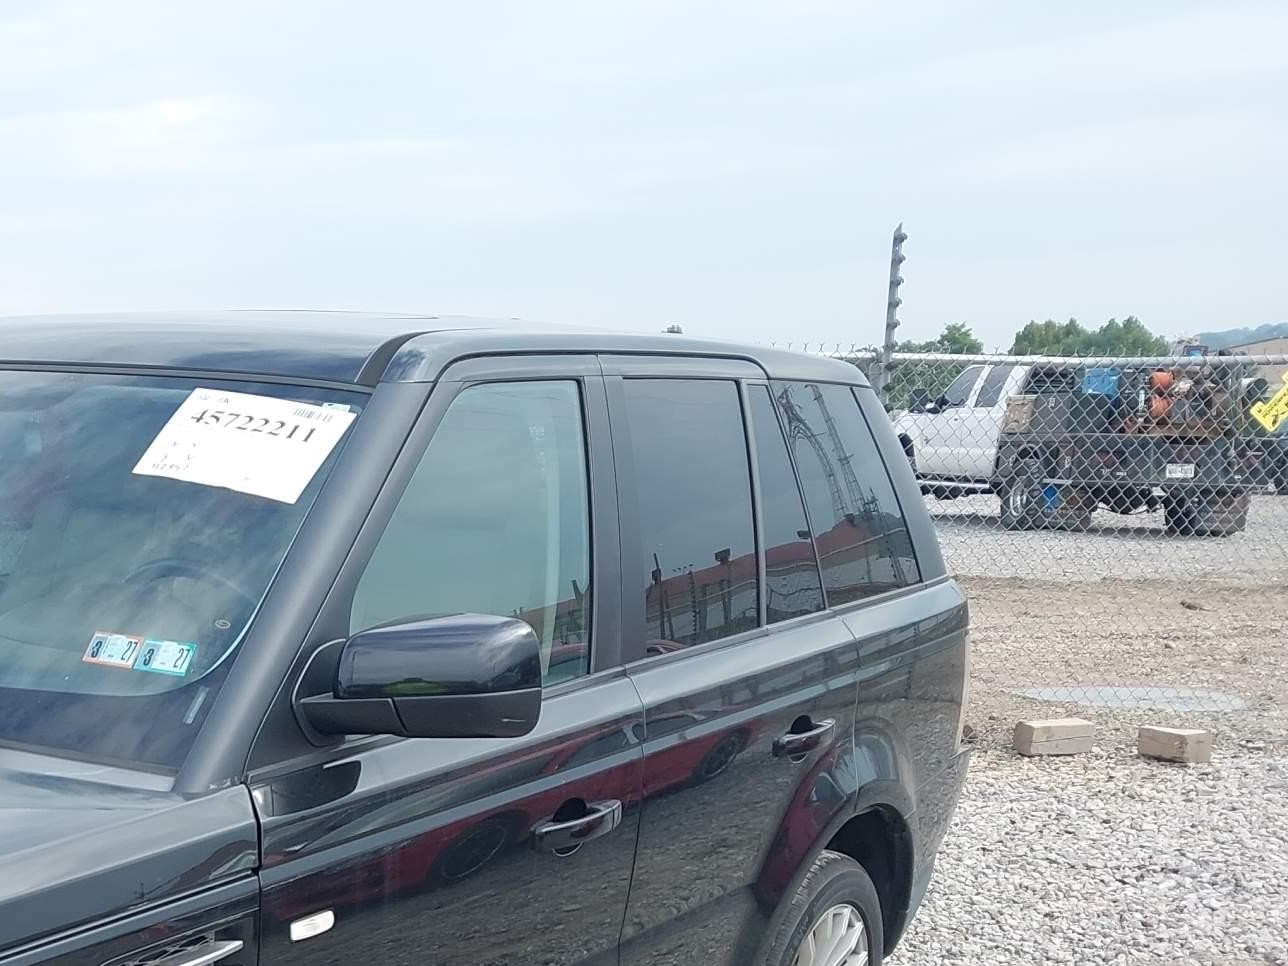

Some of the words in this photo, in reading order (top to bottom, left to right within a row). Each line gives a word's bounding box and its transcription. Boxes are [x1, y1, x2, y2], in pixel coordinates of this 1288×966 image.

[190, 408, 317, 443] 45722211
[120, 640, 139, 663] 27
[172, 647, 191, 670] 27
